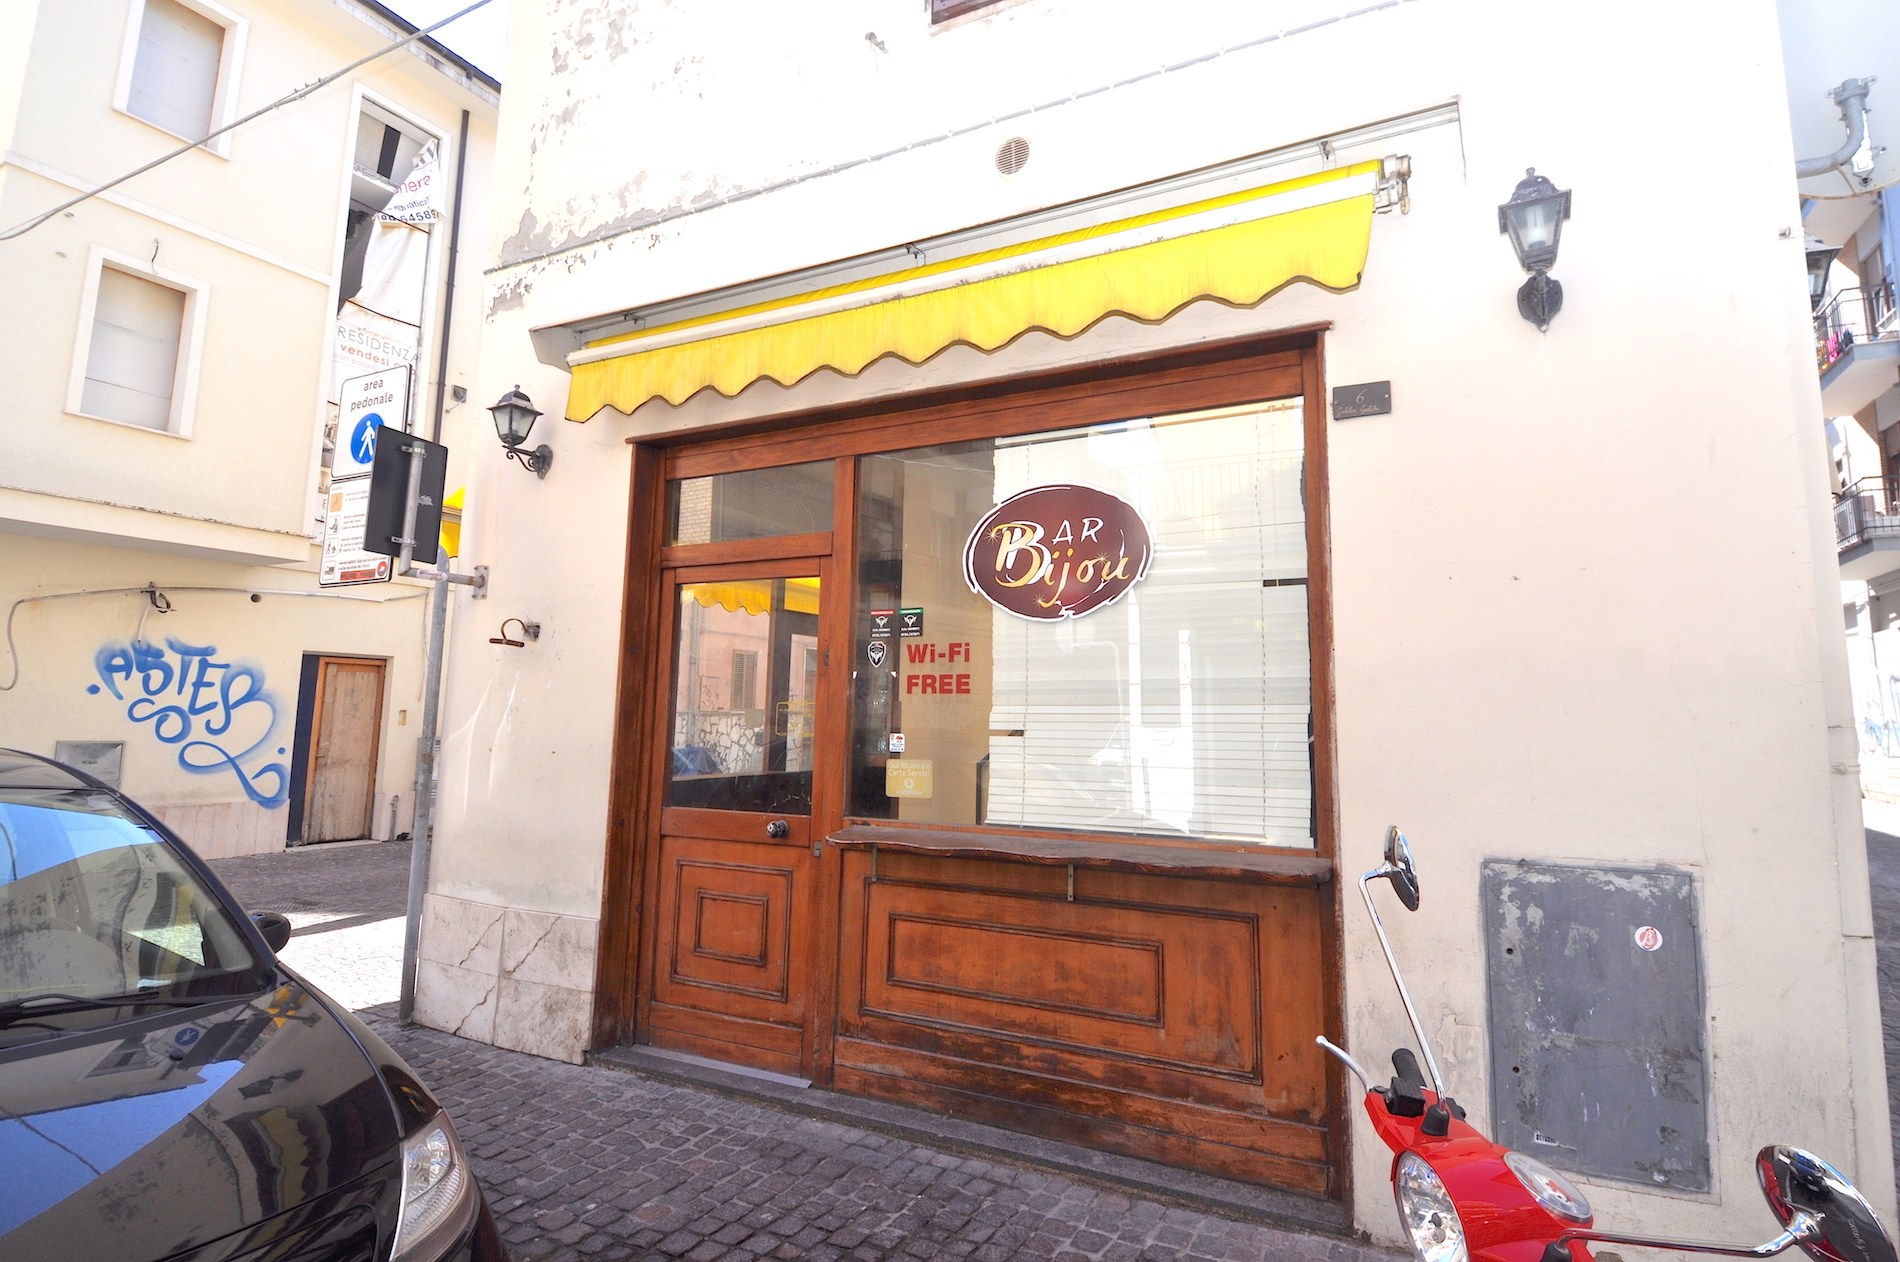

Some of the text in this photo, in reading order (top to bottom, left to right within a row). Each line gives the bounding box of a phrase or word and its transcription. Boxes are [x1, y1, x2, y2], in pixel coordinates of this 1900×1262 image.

[337, 325, 419, 362] RESIDENZA
[340, 343, 389, 366] vendesi
[363, 379, 384, 392] area
[1355, 388, 1368, 404] 6
[350, 391, 394, 413] pedonale
[992, 522, 1131, 608] Bijou
[906, 643, 970, 664] Wi-Fi
[906, 674, 971, 694] FREE
